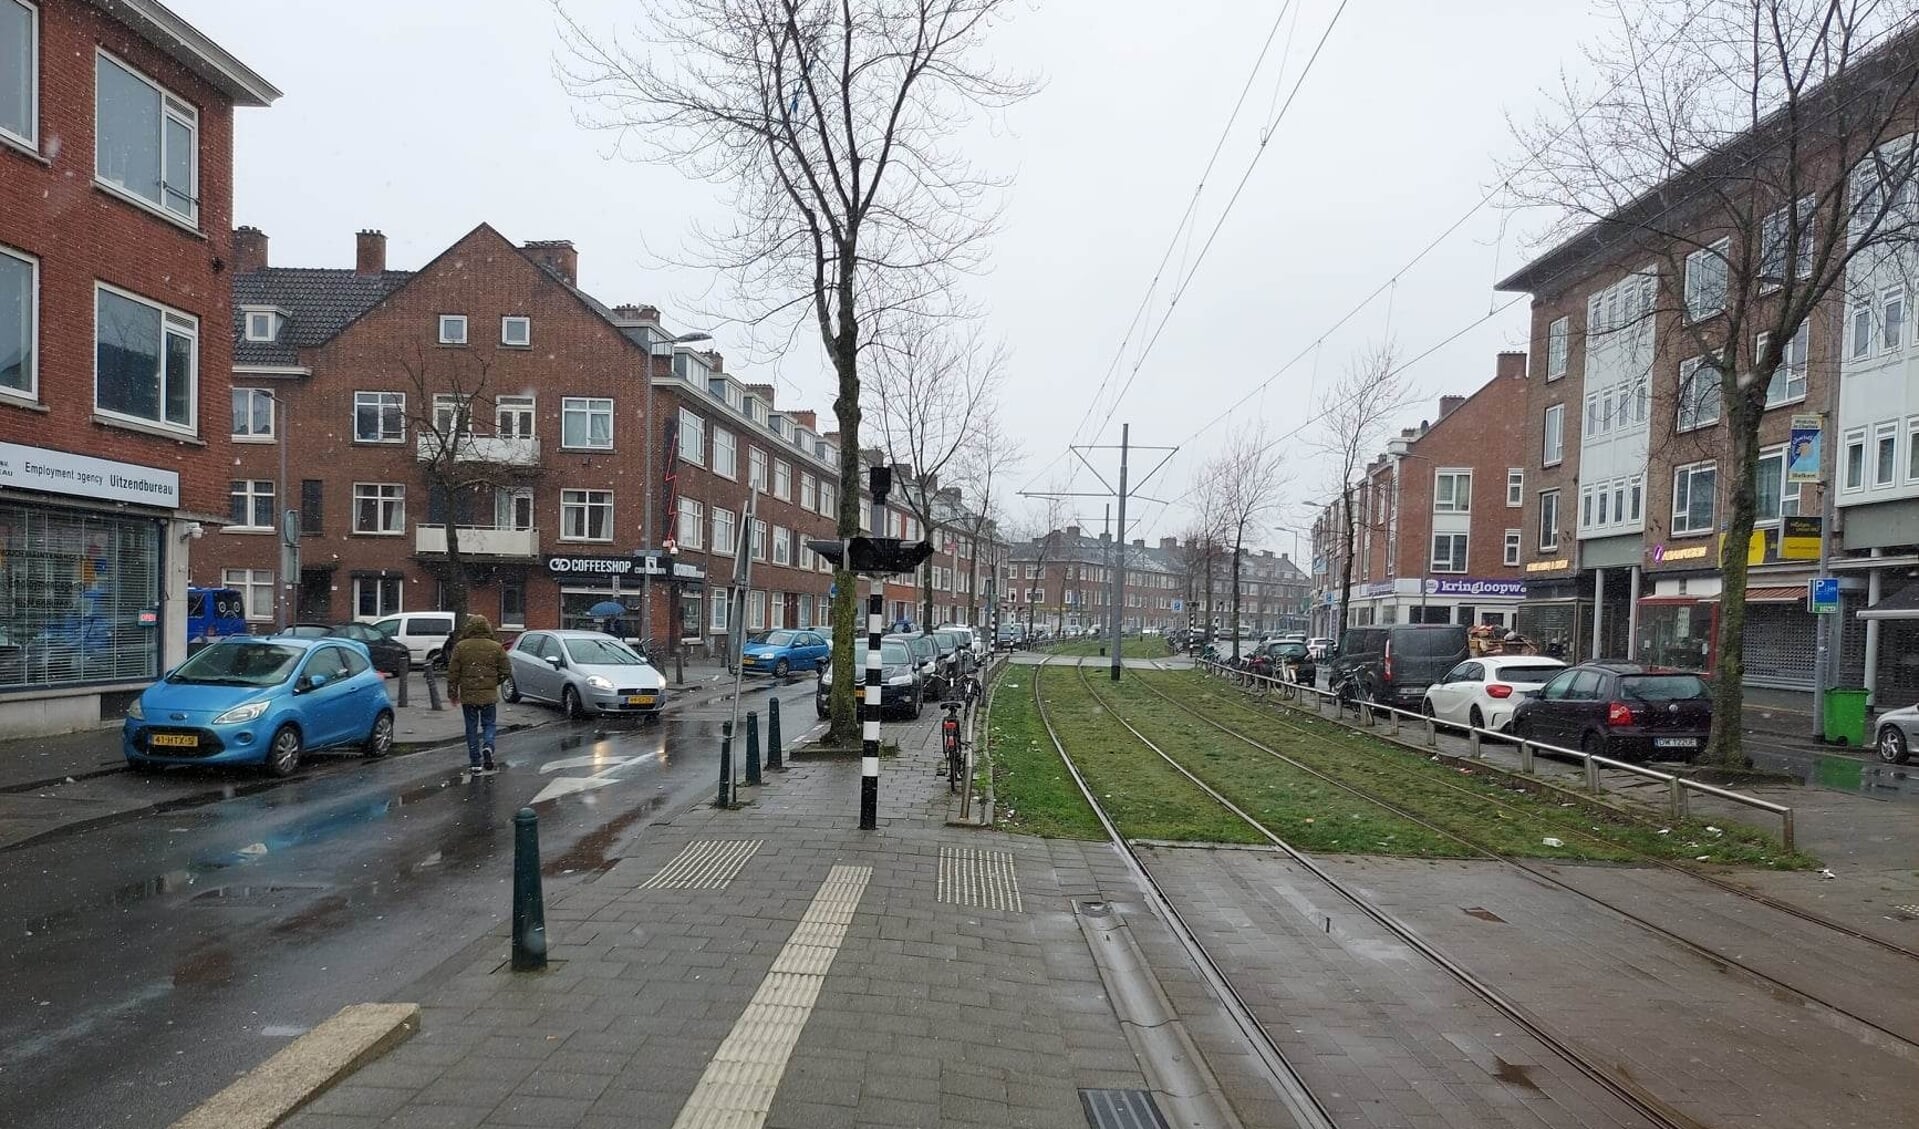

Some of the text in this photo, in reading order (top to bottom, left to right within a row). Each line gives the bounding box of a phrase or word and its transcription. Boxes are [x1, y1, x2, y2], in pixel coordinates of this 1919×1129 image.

[25, 461, 74, 479] Employment
[77, 472, 103, 486] agency
[110, 474, 173, 495] Uitzendbureau
[572, 559, 631, 573] COFFEESHOP
